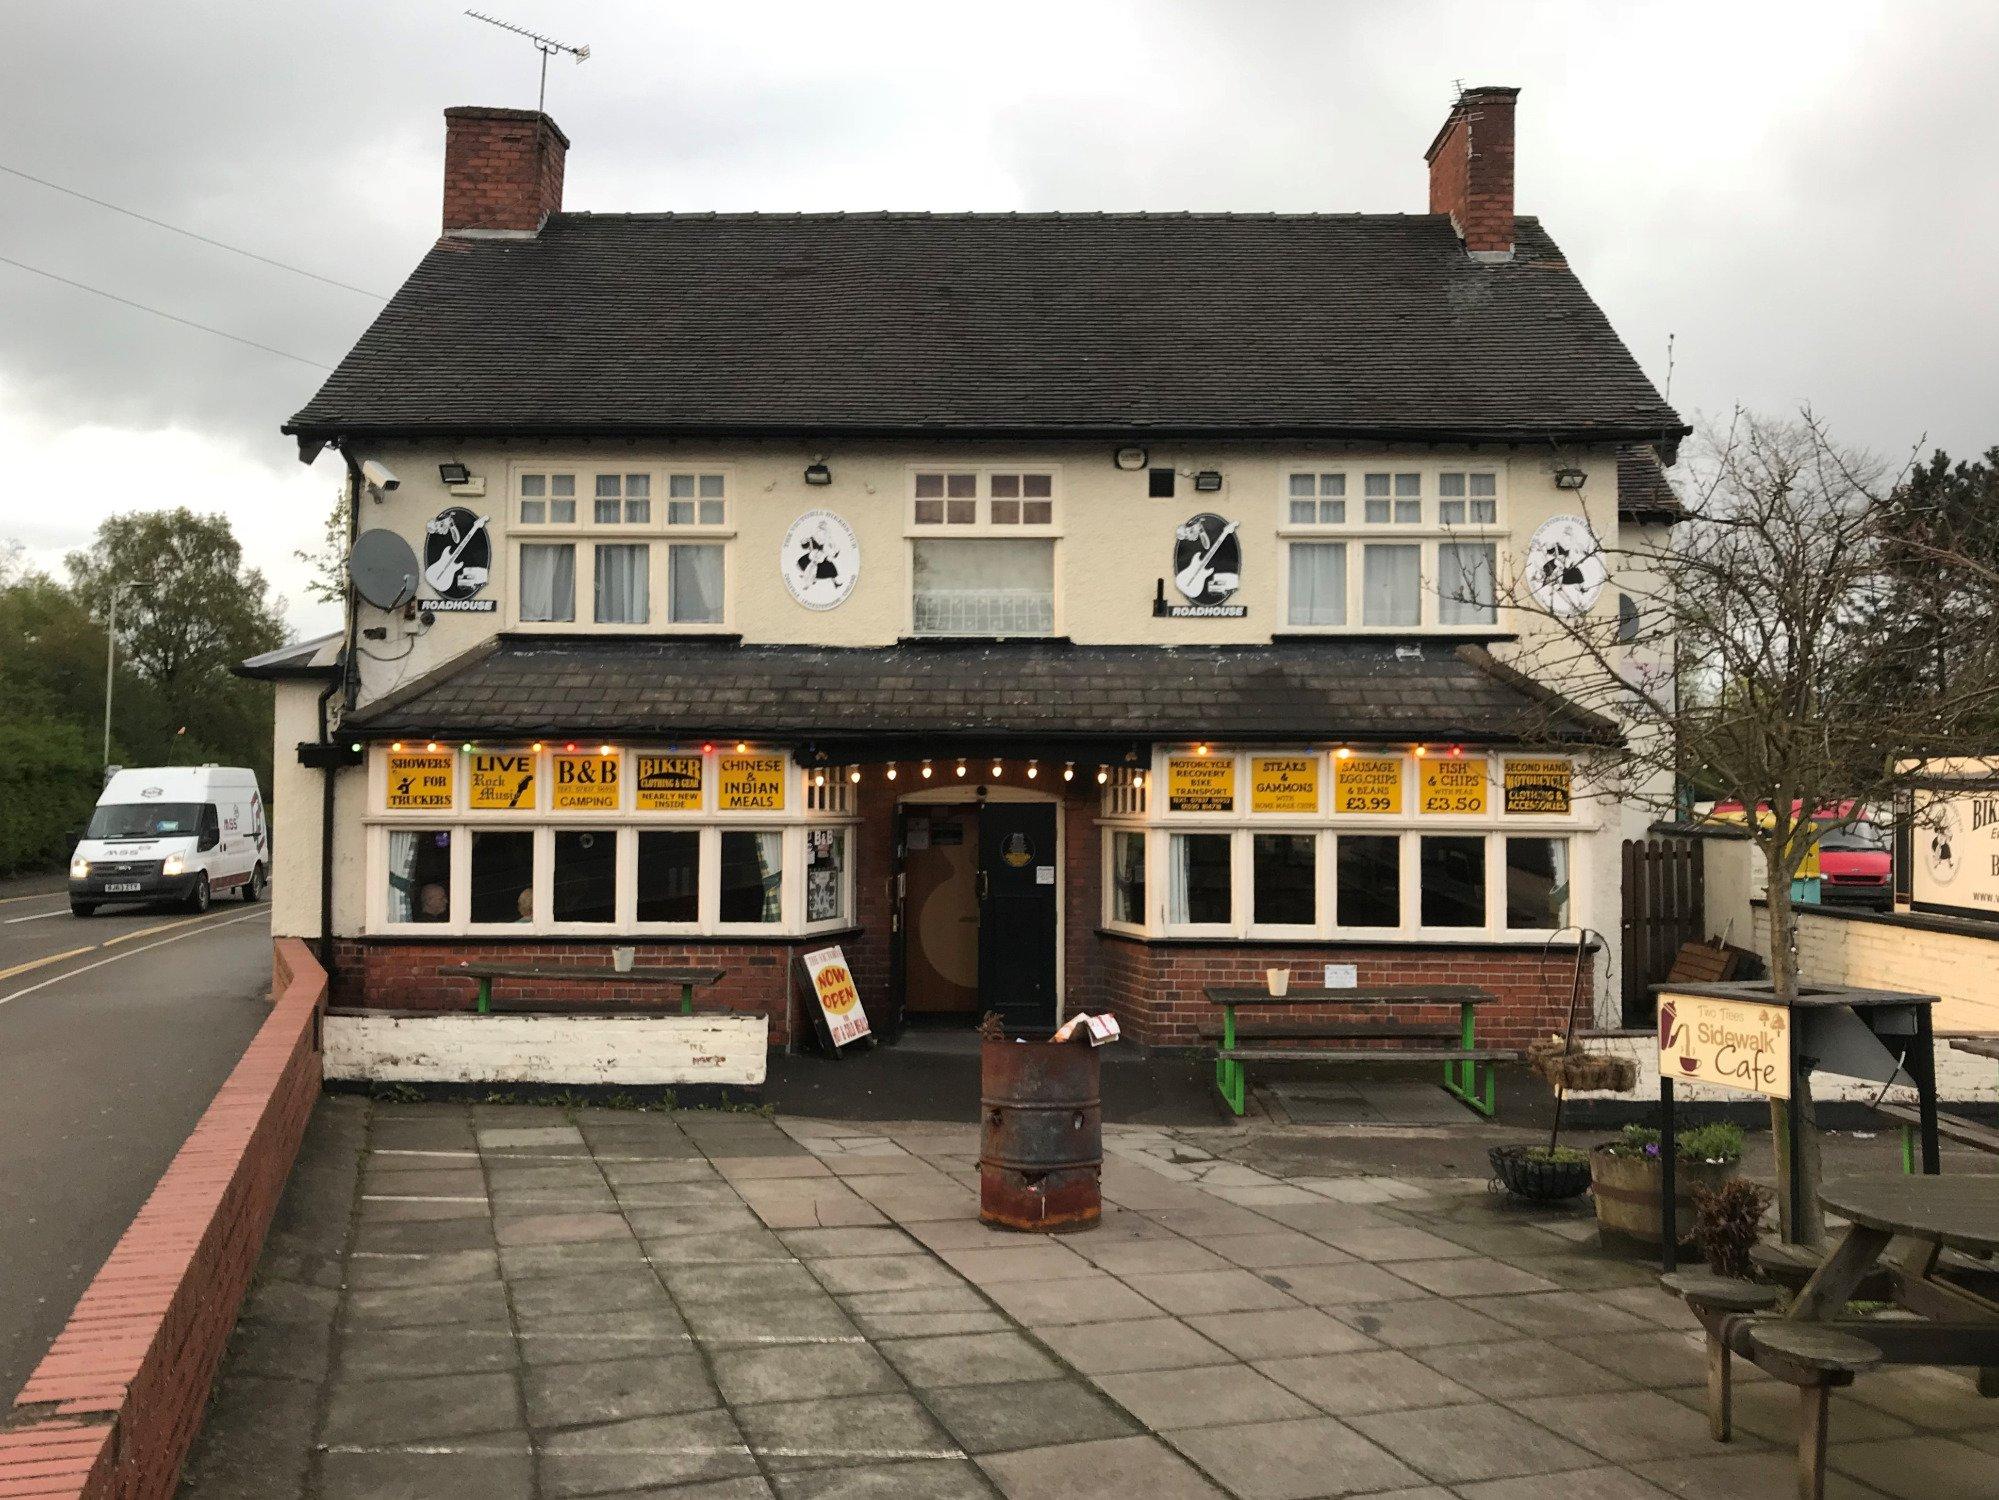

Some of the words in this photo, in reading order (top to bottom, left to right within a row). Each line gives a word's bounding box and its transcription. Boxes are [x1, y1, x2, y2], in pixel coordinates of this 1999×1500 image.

[421, 600, 493, 611] ROADHOUSE
[1172, 607, 1244, 617] ROADHOUSE
[391, 758, 451, 769] SHOWERS
[476, 756, 530, 772] LIVE
[639, 758, 701, 780] BIKER
[722, 760, 781, 772] CHINESE
[1169, 761, 1232, 769] MOTORCYCLE
[1262, 762, 1307, 772] STEAKS
[1341, 762, 1395, 772] SAUSAGE
[1439, 762, 1468, 774] FISH
[1505, 763, 1541, 772] SECOND
[558, 760, 618, 784] B&B
[746, 772, 756, 781] &
[1176, 770, 1226, 778] RECOVERY
[1280, 773, 1289, 782] &
[423, 776, 447, 787] FOR
[472, 774, 505, 787] Rock
[1427, 776, 1437, 786] &
[1441, 775, 1479, 787] CHIPS
[725, 782, 779, 794] INDIAN
[1175, 788, 1227, 796] TRANSPORT
[1256, 783, 1313, 793] GAMMONS
[1357, 786, 1389, 795] BEANS
[390, 795, 452, 806] TRUCKERS
[560, 797, 613, 807] CAMPING
[730, 796, 773, 807] MEALS
[1346, 797, 1391, 810] £3.99
[1426, 797, 1482, 811] £3.50
[817, 968, 846, 990] NOW
[822, 985, 855, 1009] OPEN
[1698, 1005, 1717, 1018] Two
[1721, 1008, 1745, 1023] Trees
[1698, 1022, 1775, 1054] Sidewalk
[1715, 1044, 1776, 1091] Cafe
